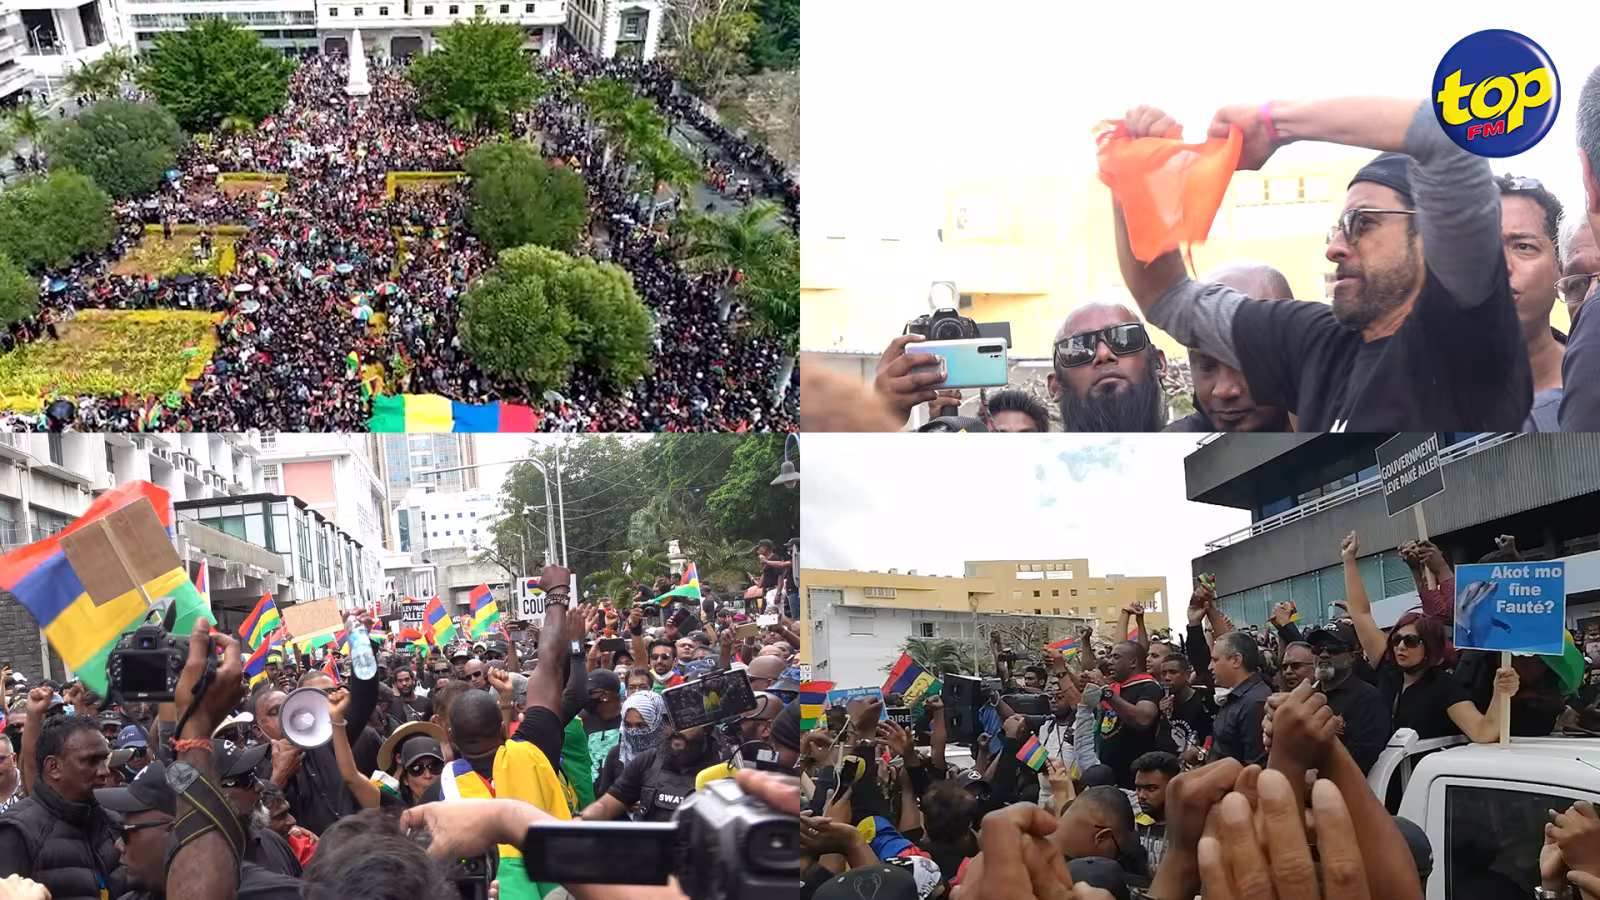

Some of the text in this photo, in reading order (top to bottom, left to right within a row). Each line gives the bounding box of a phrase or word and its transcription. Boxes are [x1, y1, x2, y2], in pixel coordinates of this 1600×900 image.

[1381, 435, 1436, 480] GOUVERNMENT
[1384, 477, 1401, 496] LEVE
[1418, 455, 1440, 478] ALLER
[1491, 565, 1562, 579] Akot mo
[1508, 582, 1542, 596] fine
[523, 598, 547, 615] COU
[1496, 600, 1555, 614] Fauté?
